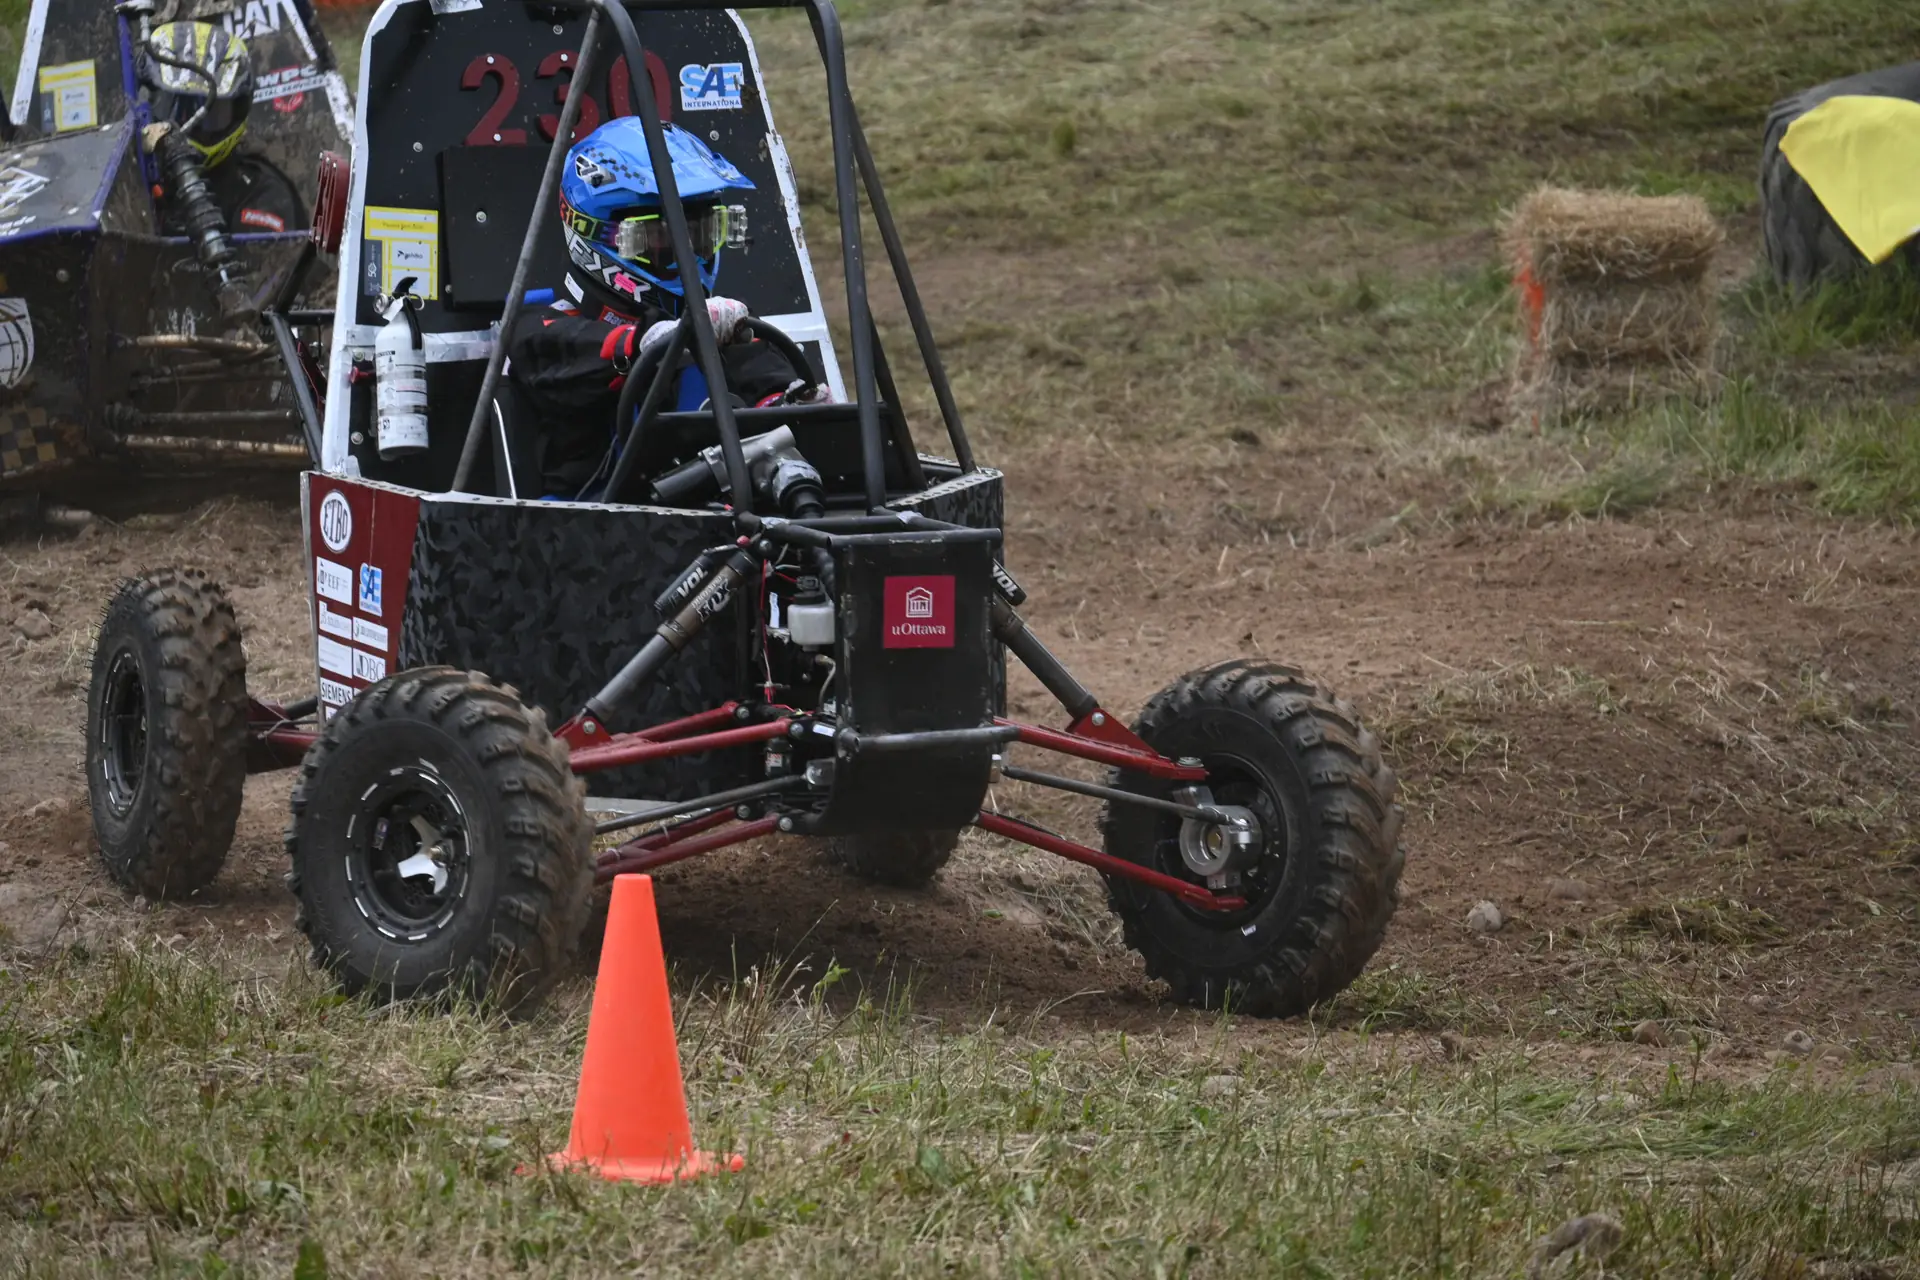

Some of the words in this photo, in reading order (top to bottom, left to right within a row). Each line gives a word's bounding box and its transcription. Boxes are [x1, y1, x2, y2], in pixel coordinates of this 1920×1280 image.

[461, 50, 672, 146] 230
[681, 64, 741, 98] SAE
[684, 98, 740, 108] INTERNATIONA
[568, 232, 652, 303] FXR
[361, 565, 381, 603] SAE
[891, 622, 946, 637] uOttawa
[321, 682, 352, 705] SIEMENS
